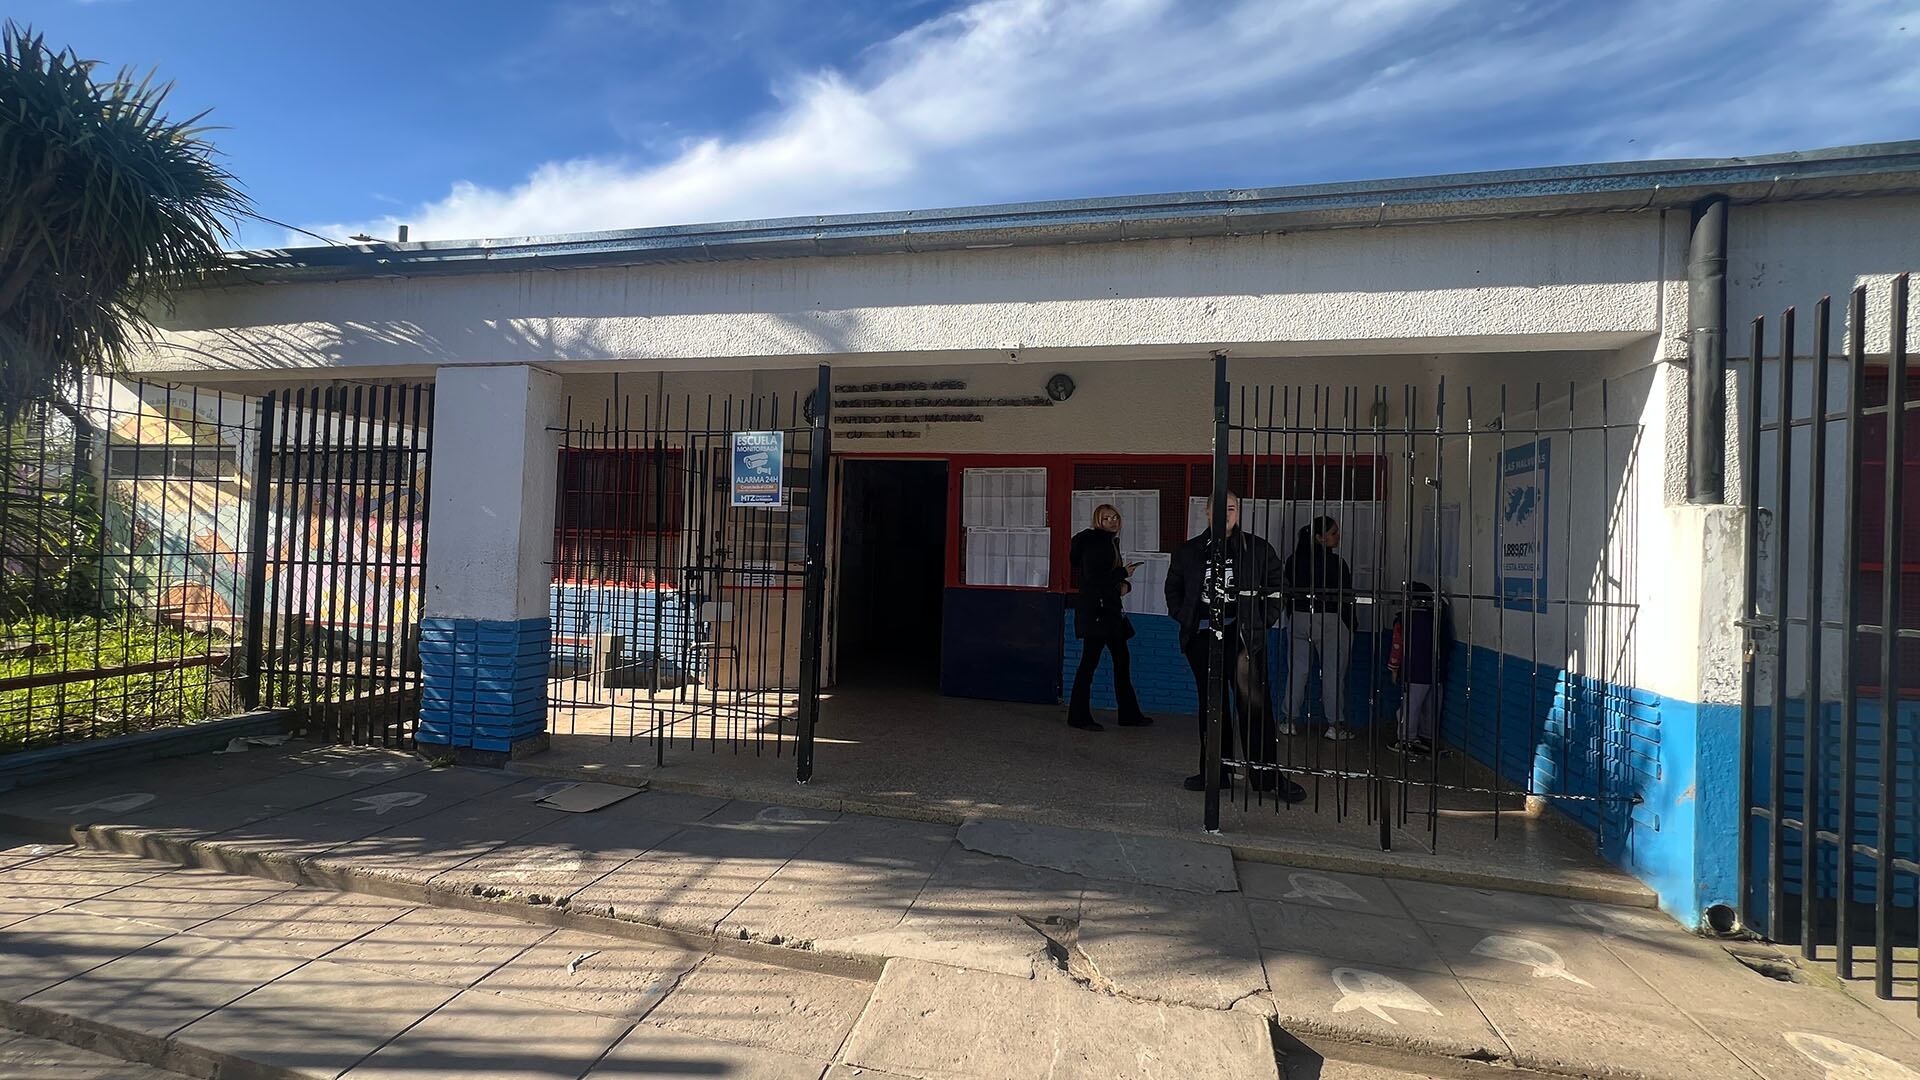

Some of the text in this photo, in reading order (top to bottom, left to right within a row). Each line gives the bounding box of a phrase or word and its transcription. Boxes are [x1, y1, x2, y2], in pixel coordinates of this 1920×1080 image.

[834, 415, 881, 424] PARTIDO
[884, 415, 902, 423] DE
[904, 414, 920, 423] LA
[737, 436, 777, 445] ESCUELA
[736, 475, 779, 484] ALARMA 24H
